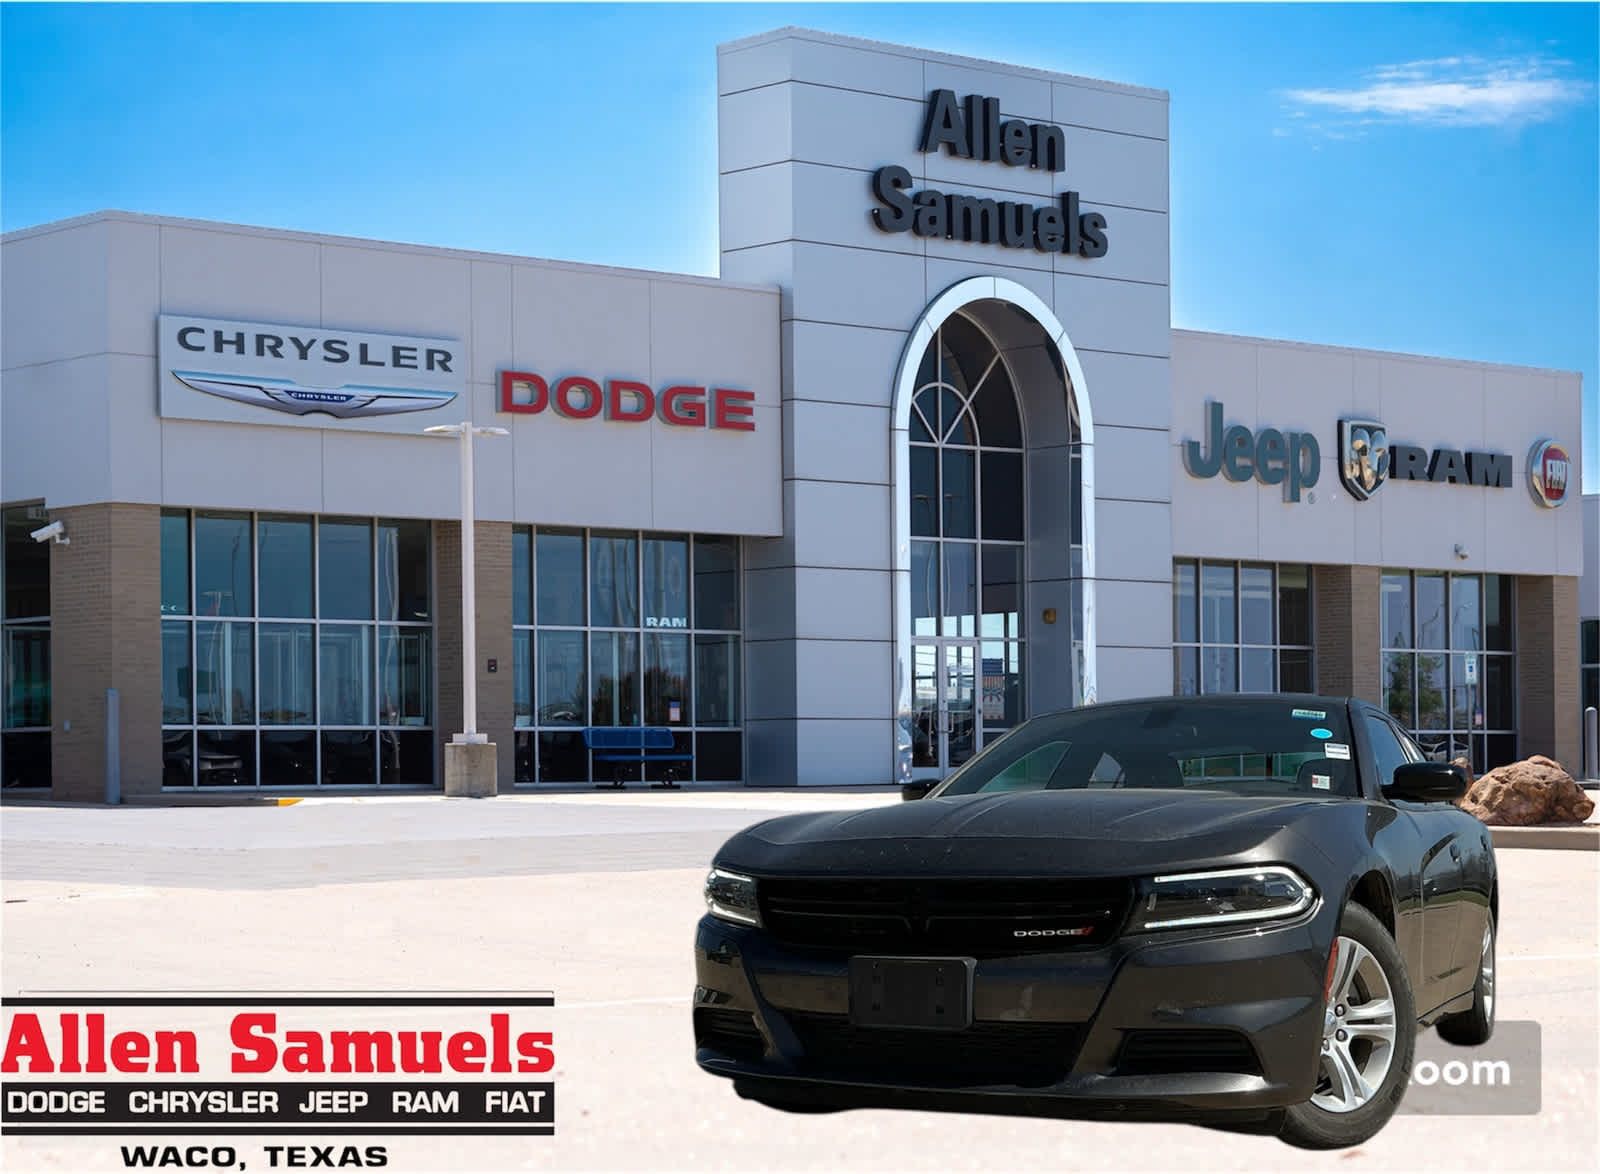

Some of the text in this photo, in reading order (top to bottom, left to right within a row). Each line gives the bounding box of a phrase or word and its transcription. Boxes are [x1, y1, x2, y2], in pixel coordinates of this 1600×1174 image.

[919, 88, 1066, 172] Allen
[872, 165, 1108, 258] Samuels
[177, 326, 453, 372] CHRYSLER
[291, 392, 347, 401] CHRYSLER
[496, 370, 755, 432] DODGE
[1182, 400, 1320, 503] Jeep
[1389, 444, 1512, 488] RAM
[1546, 459, 1567, 489] FIAT
[646, 616, 687, 628] RAM
[1013, 928, 1084, 937] DODGE
